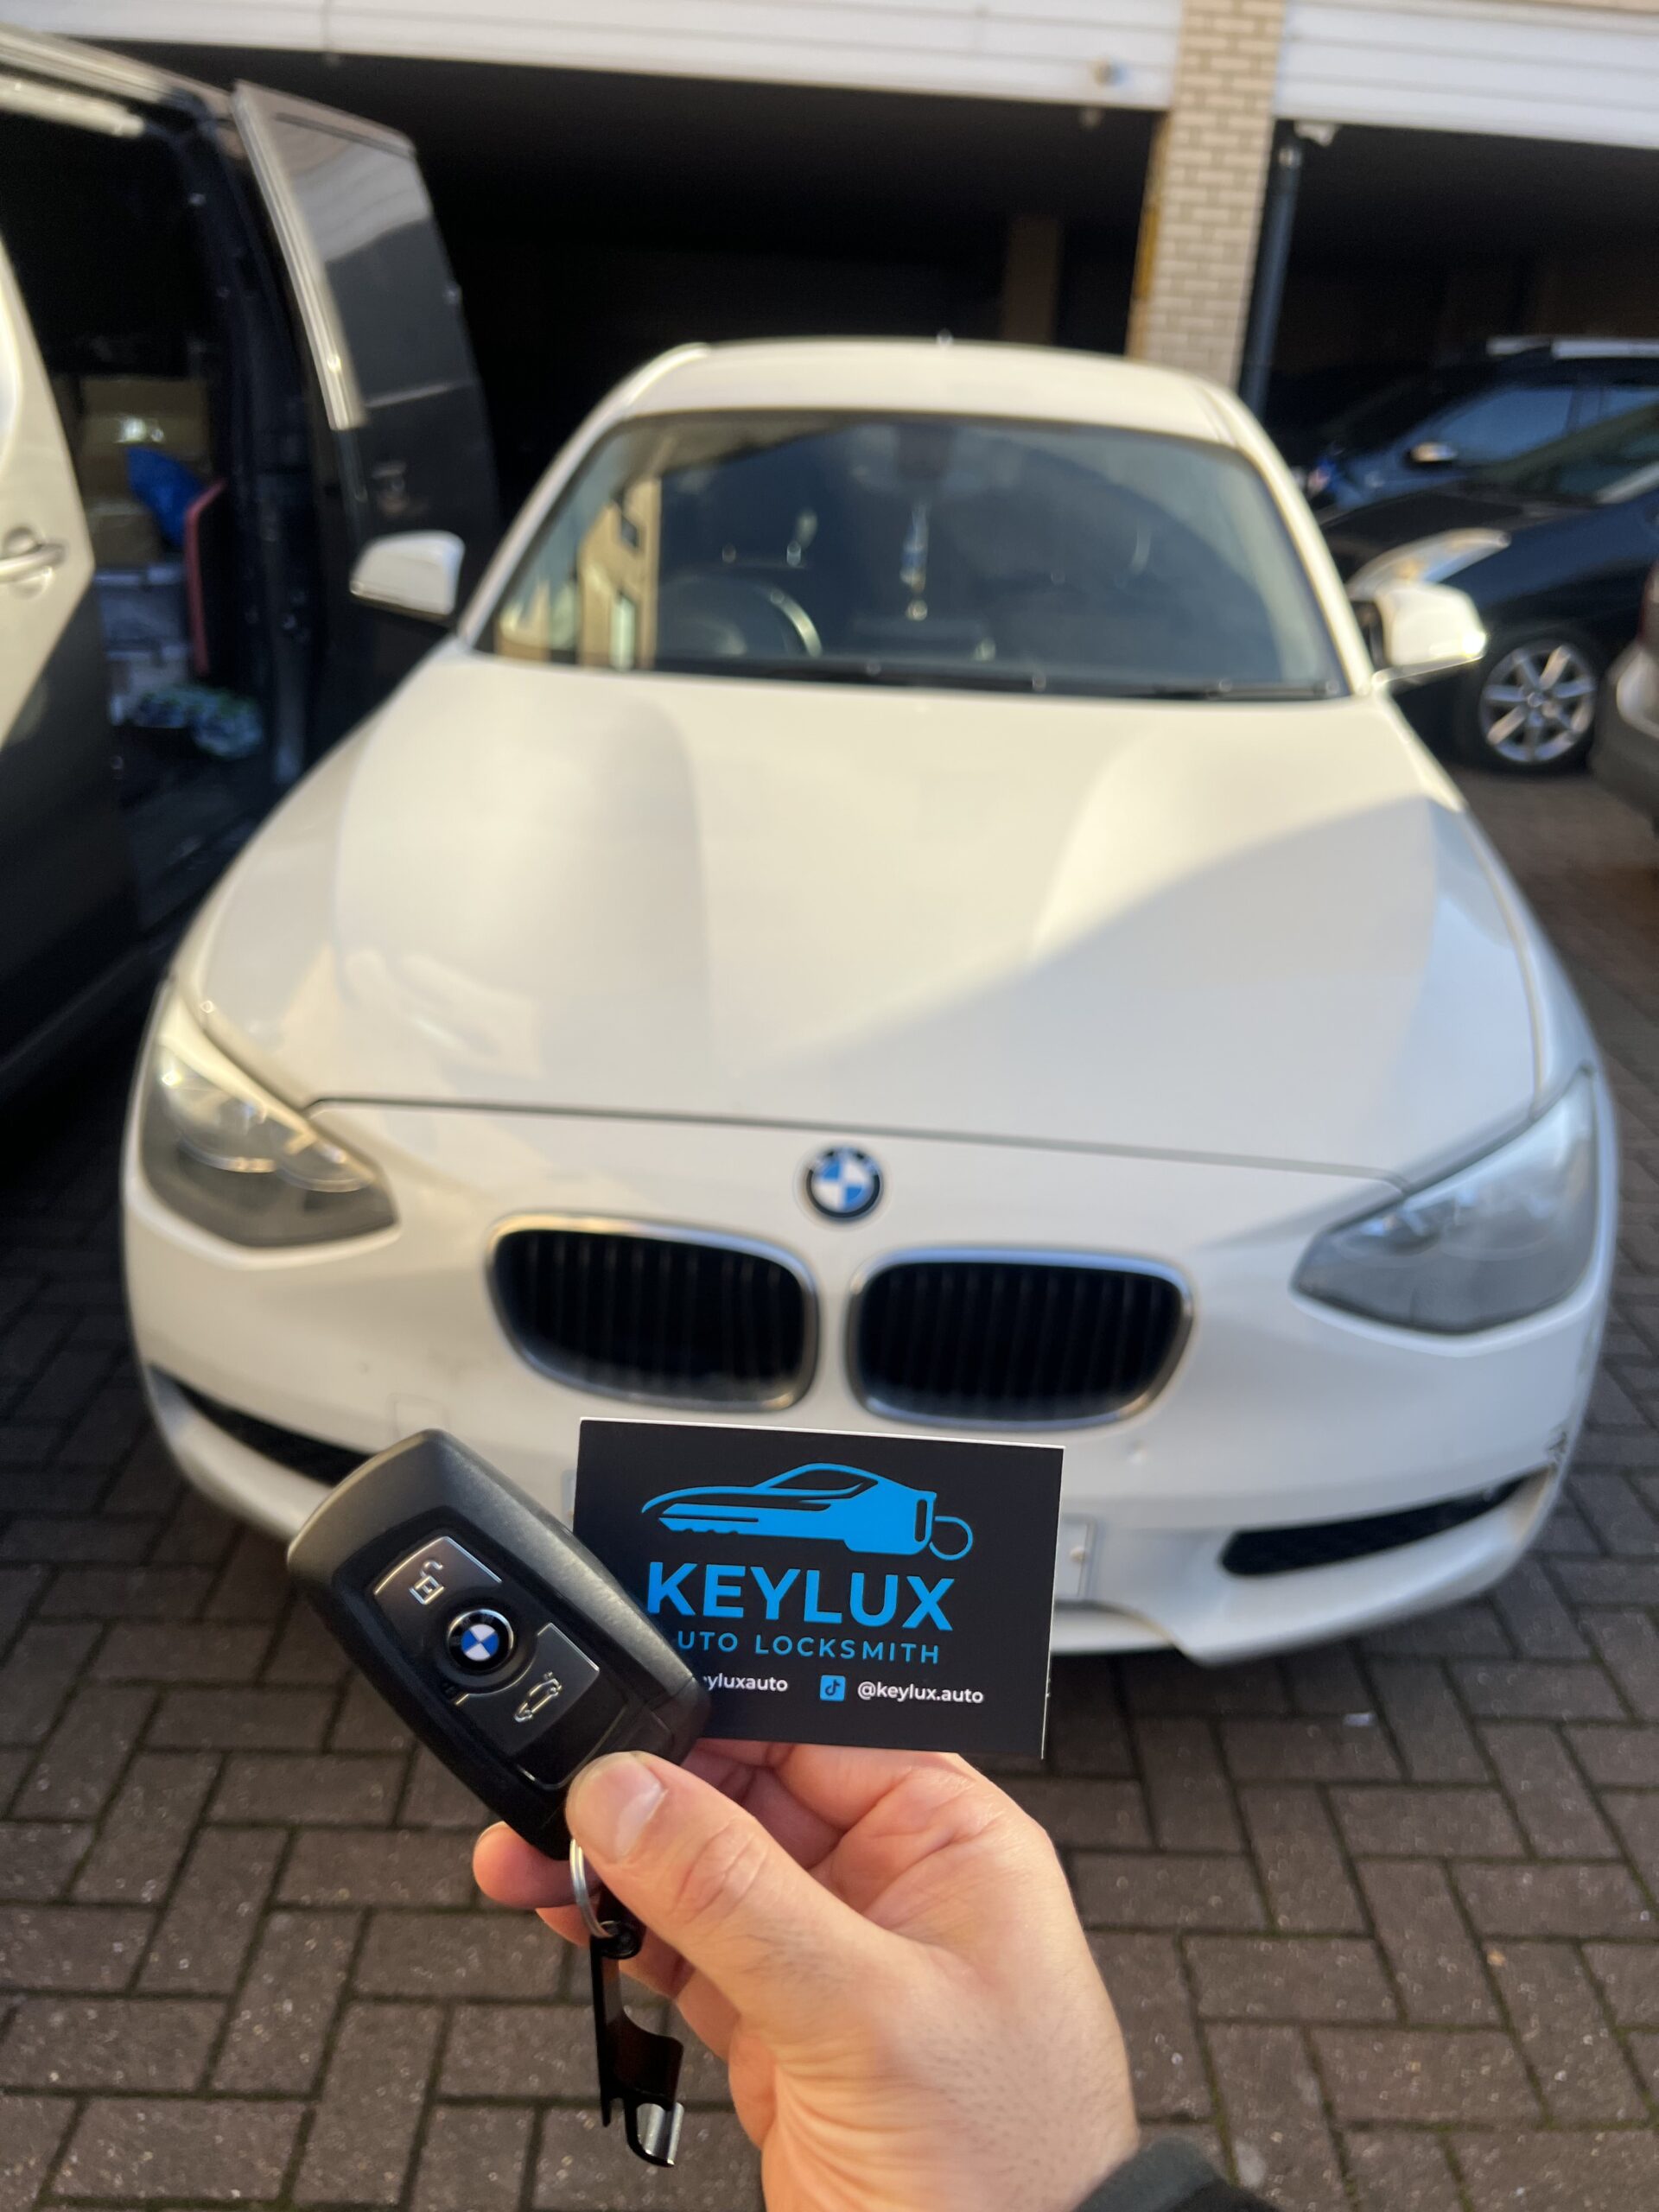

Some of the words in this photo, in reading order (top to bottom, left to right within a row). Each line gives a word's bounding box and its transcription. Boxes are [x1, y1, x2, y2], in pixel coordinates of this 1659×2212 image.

[645, 1561, 955, 1631] KEYLUX
[677, 1630, 738, 1652] UTO
[754, 1634, 939, 1664] LOCKSMITH
[703, 1672, 789, 1693] yluxauto
[857, 1681, 984, 1704] @keylux.auto
